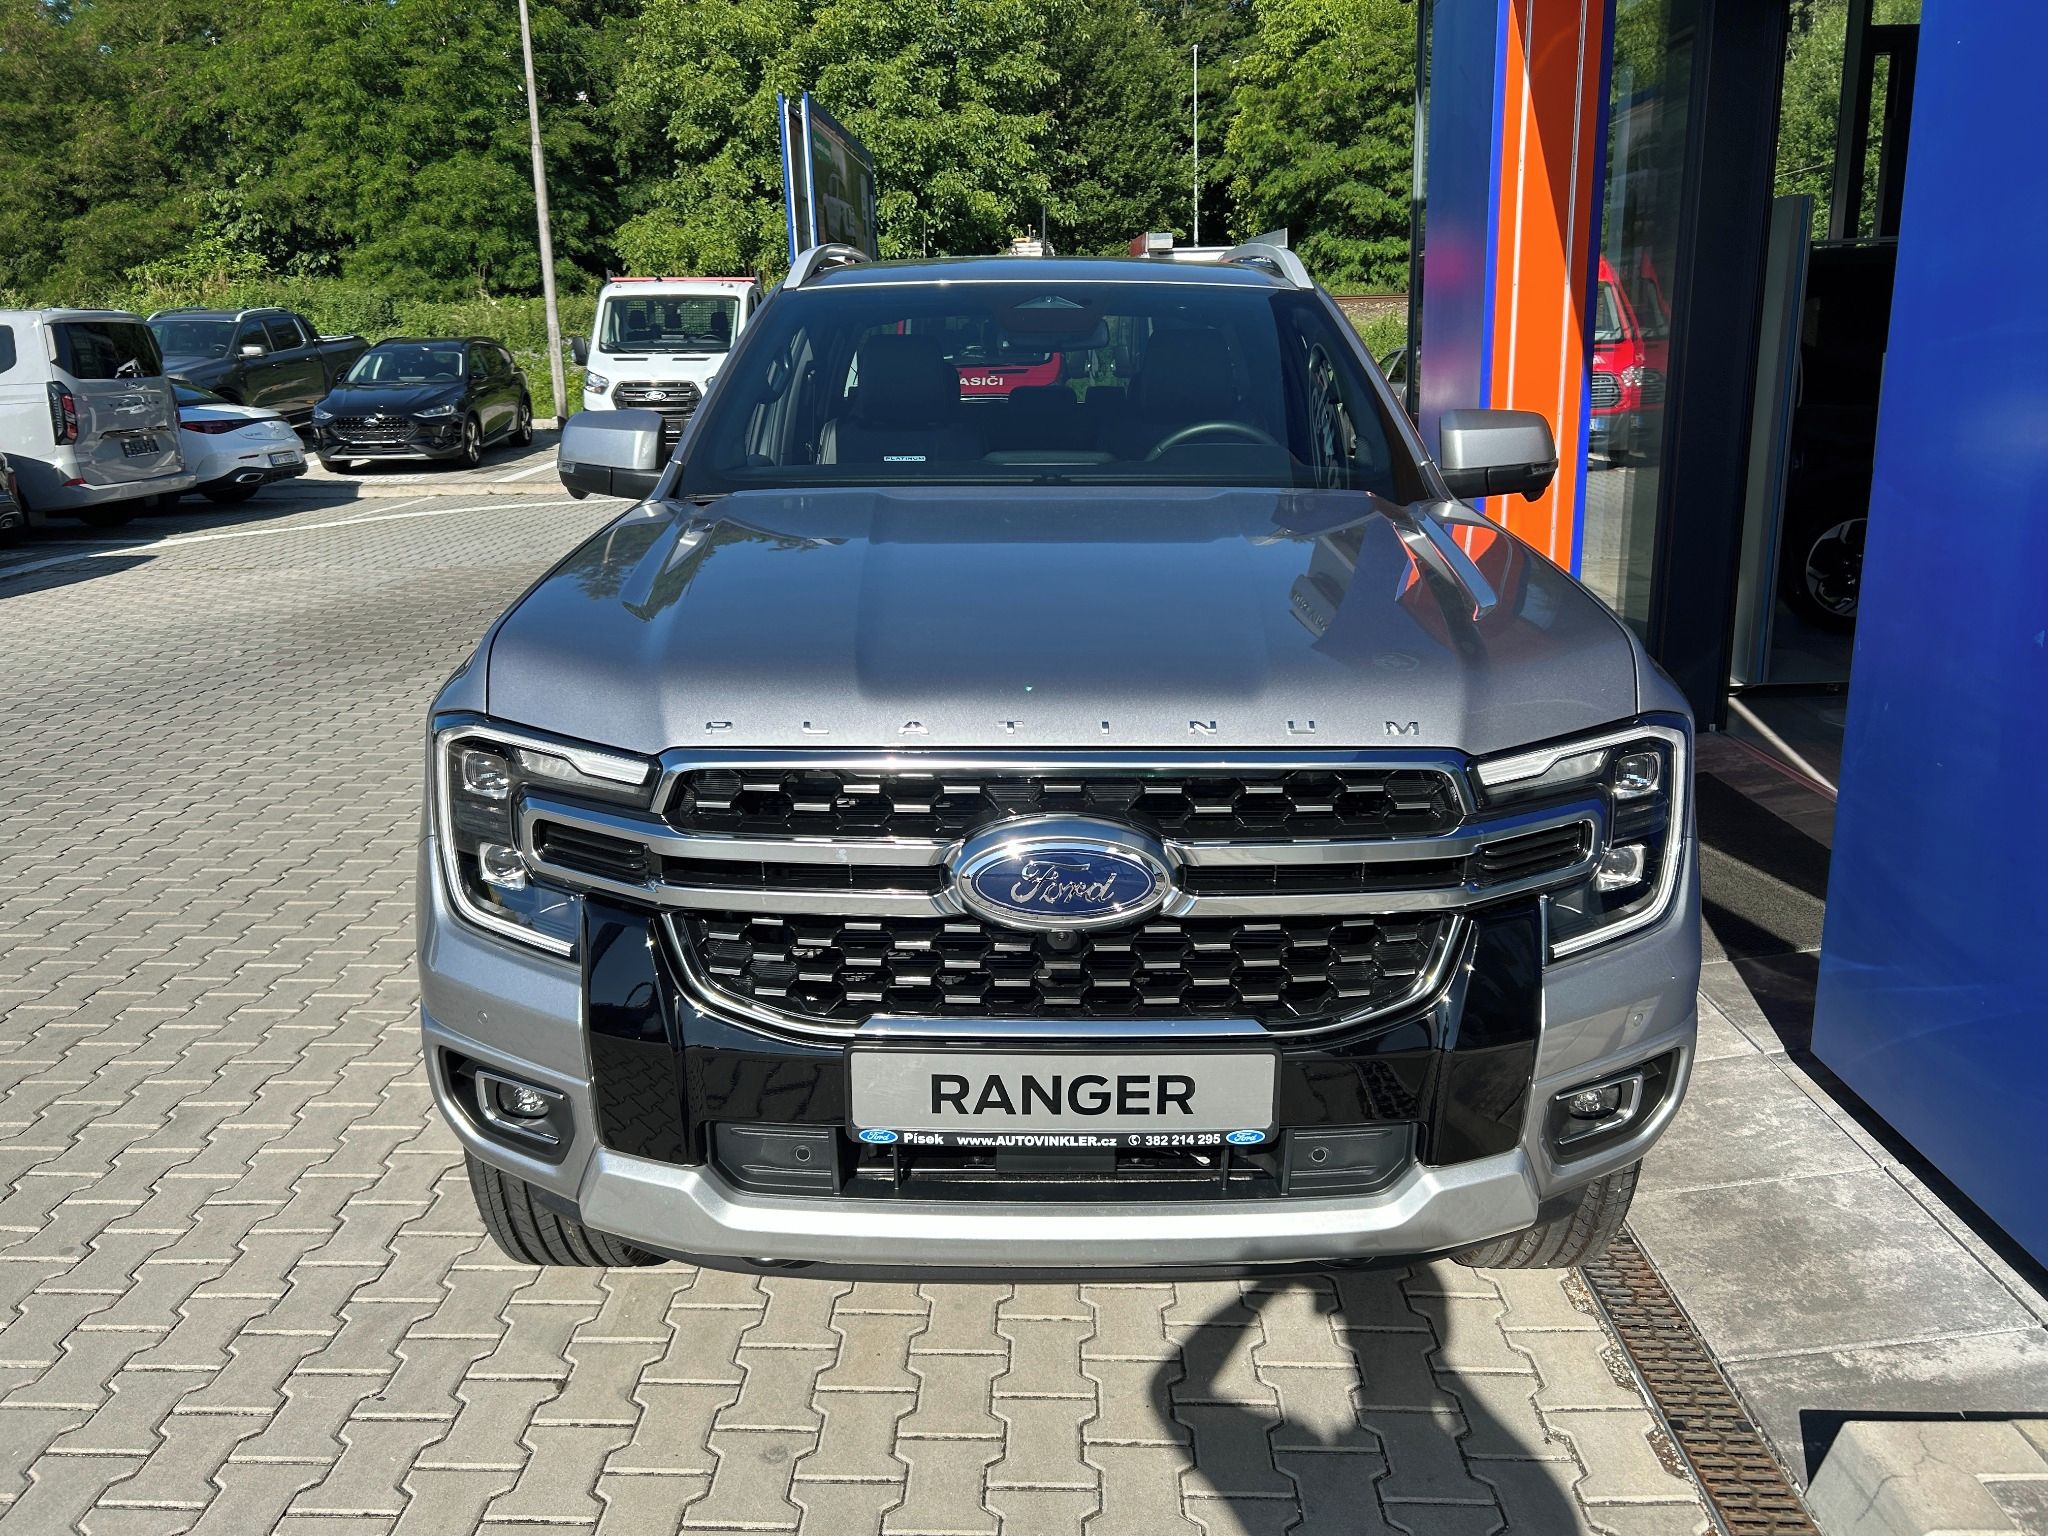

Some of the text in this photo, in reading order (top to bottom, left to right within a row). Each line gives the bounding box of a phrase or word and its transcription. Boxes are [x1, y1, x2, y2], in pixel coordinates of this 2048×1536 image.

[960, 376, 1003, 386] ASIČI
[705, 721, 1420, 736] PLATINUM
[1010, 860, 1118, 904] Ford
[931, 1074, 1196, 1116] RANGER
[866, 1130, 892, 1142] Ford
[903, 1132, 1221, 1147] Písek www.AUTOVINKLER.cz 382 214 295
[1233, 1131, 1258, 1142] Ford
